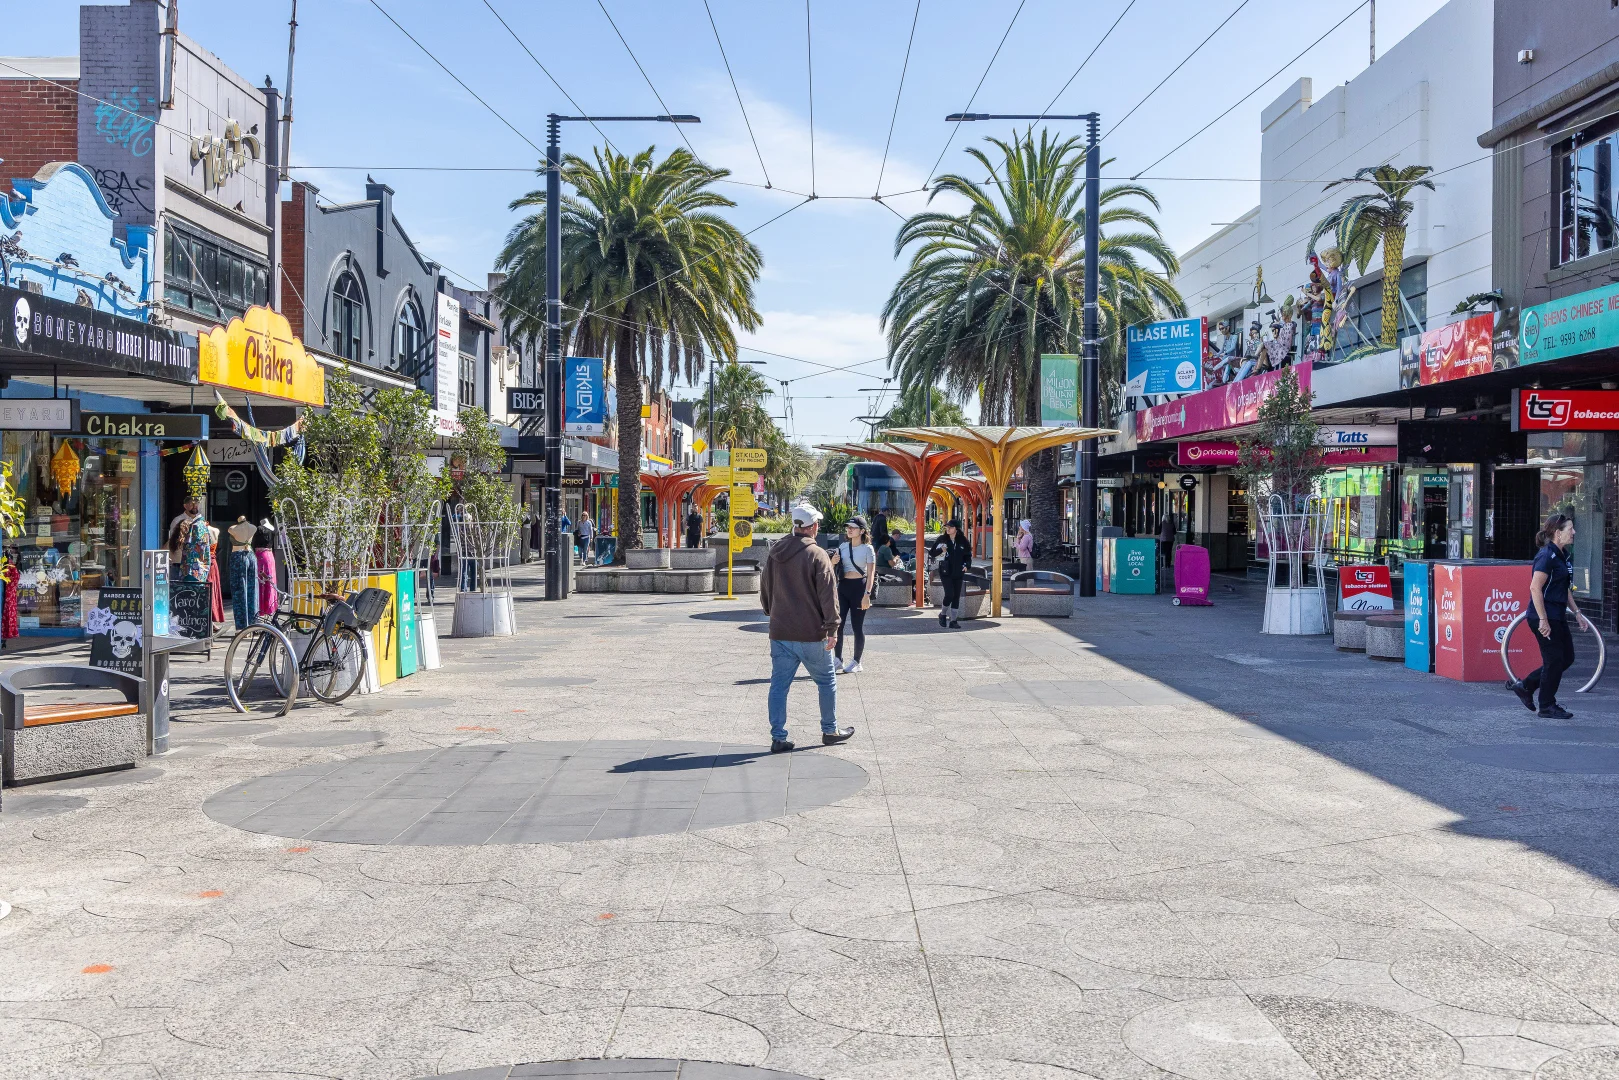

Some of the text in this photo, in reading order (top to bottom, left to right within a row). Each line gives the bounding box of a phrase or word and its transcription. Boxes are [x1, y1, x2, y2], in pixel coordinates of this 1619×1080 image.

[1571, 299, 1604, 320] CHINESE
[34, 311, 191, 368] BONEYARD BARBER BAR TATTOO
[1130, 324, 1194, 342] LEASE ME.
[1560, 332, 1576, 346] 9593
[1579, 327, 1596, 342] 6268
[244, 336, 293, 385] Chakra
[1526, 393, 1619, 426] tsg tobacco
[87, 415, 166, 436] Chakra
[1336, 431, 1369, 443] Tatts
[1492, 589, 1513, 599] live
